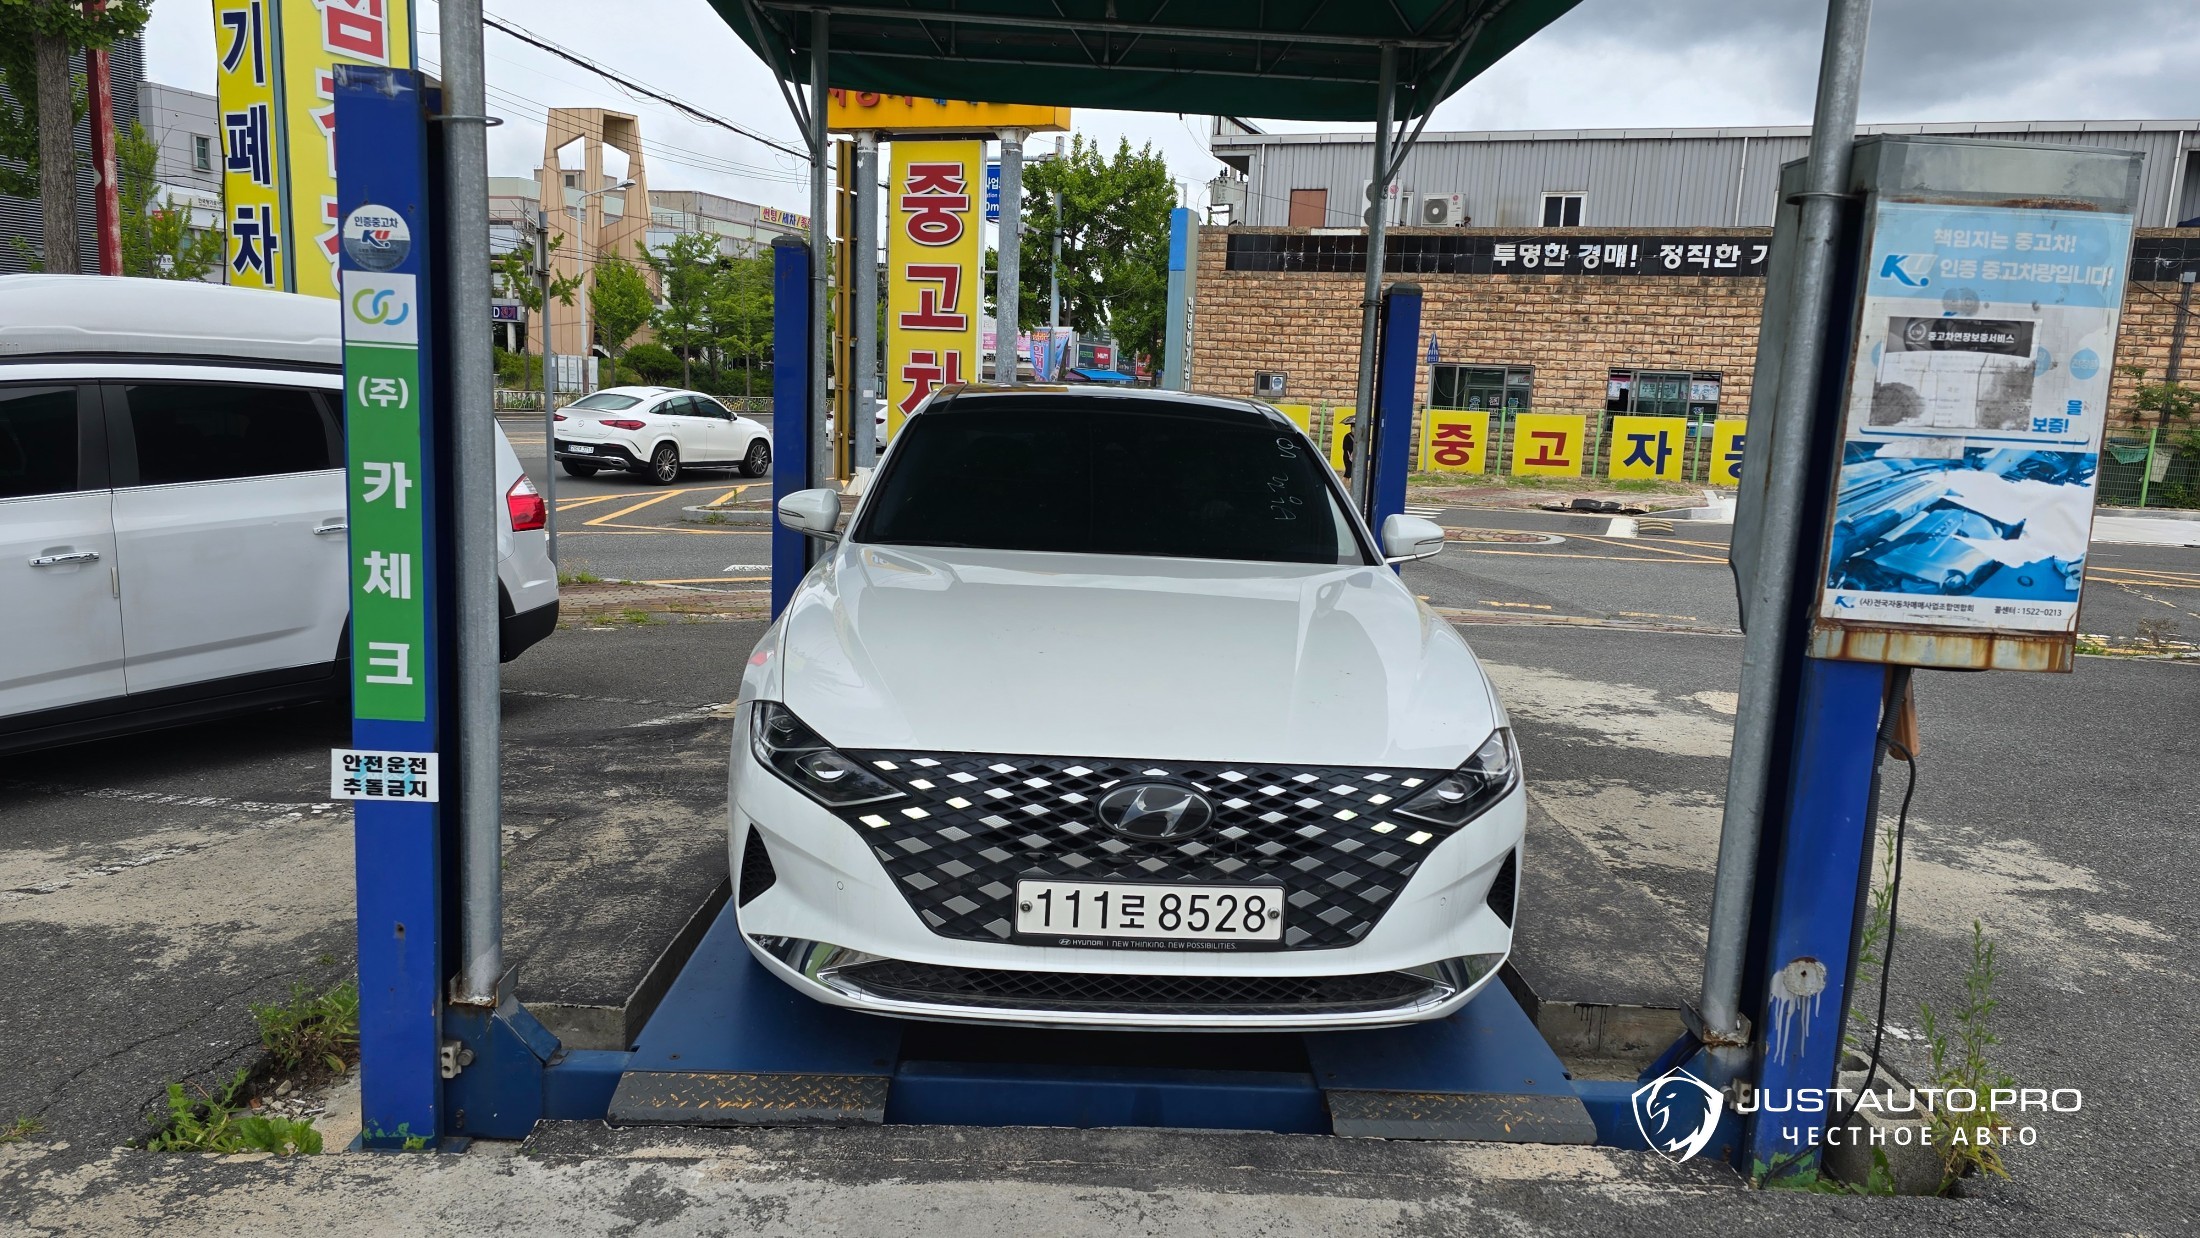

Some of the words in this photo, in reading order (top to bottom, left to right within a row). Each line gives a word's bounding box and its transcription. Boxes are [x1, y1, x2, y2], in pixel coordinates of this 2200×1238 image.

[354, 215, 398, 229] 인증중고차
[1933, 228, 2009, 251] 책임지는
[2015, 231, 2077, 254] 중고차!
[1493, 242, 1569, 269] 투명한
[1578, 243, 1638, 270] 경매!
[1659, 243, 1742, 270] 정직한
[1940, 258, 1978, 280] 인증
[1982, 260, 2114, 287] 중고차량입니다!
[1927, 330, 2015, 345] 중고차연장보증서비스
[2031, 416, 2070, 434] 보증!
[2021, 606, 2063, 617] 1522-0213
[342, 754, 428, 775] 안전운전
[343, 778, 428, 798] 추돌금지
[1158, 892, 1266, 933] 8528
